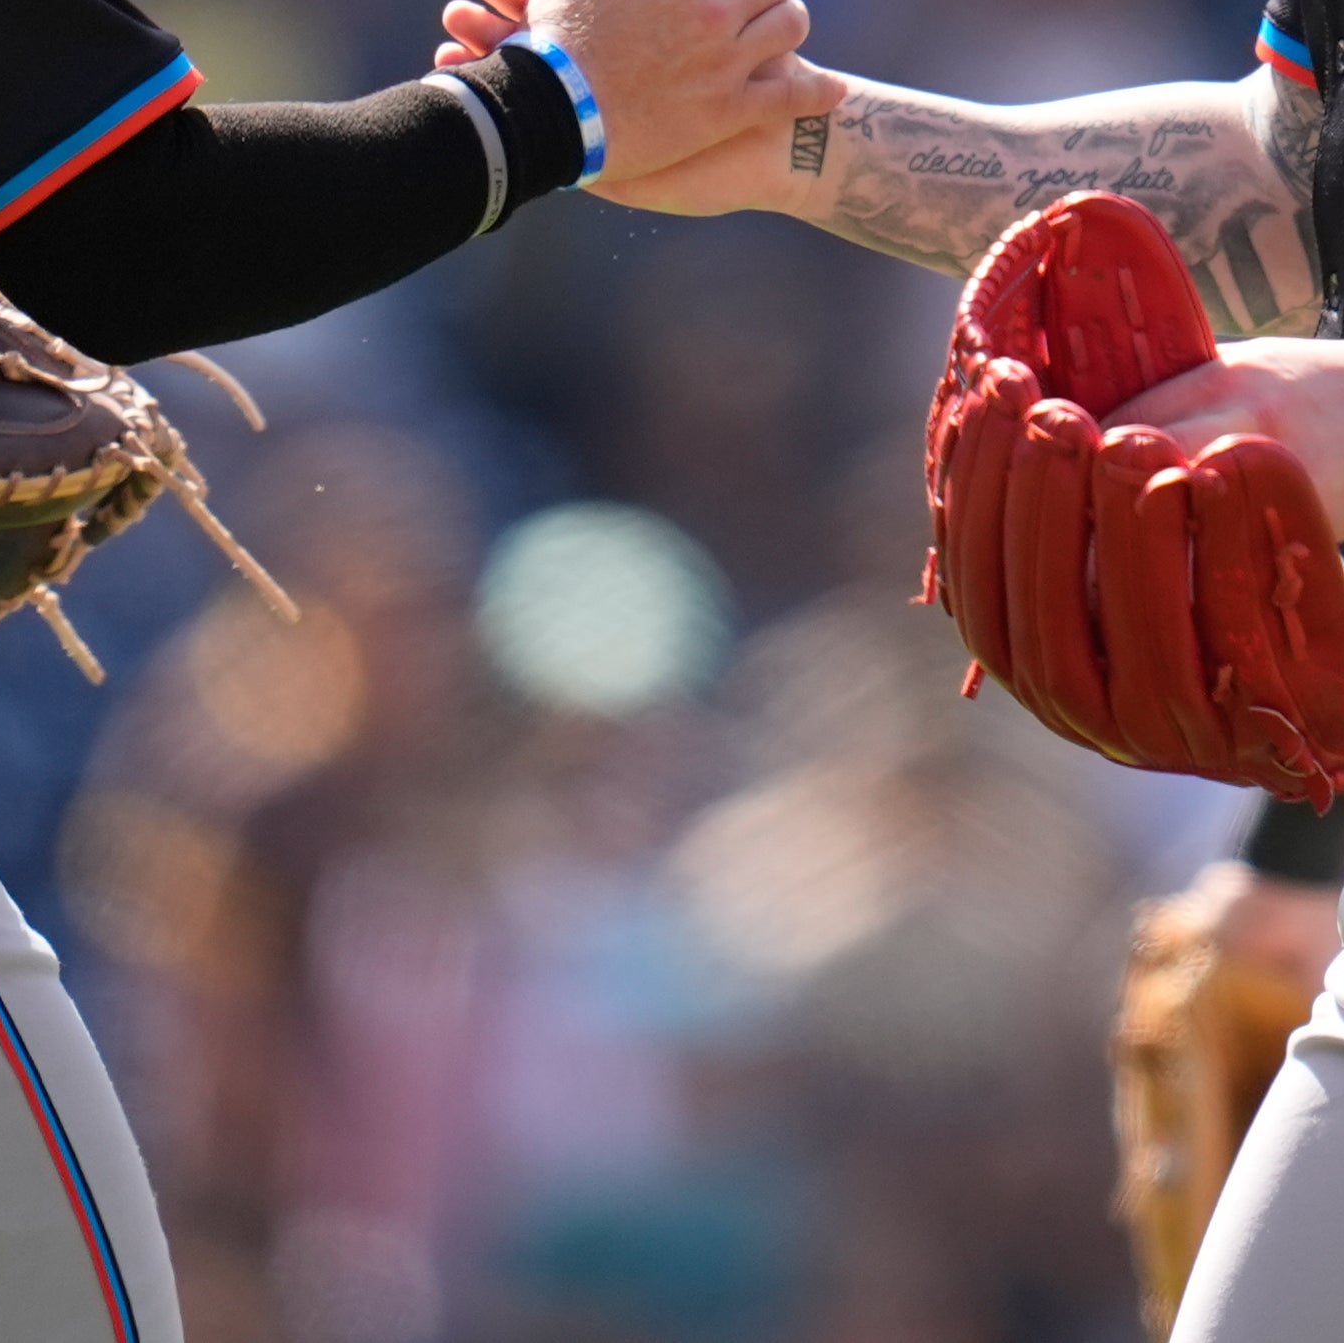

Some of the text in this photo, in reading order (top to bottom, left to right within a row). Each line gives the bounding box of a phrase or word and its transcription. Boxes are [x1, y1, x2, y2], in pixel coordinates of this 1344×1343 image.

[908, 145, 1177, 207] decide your fate
